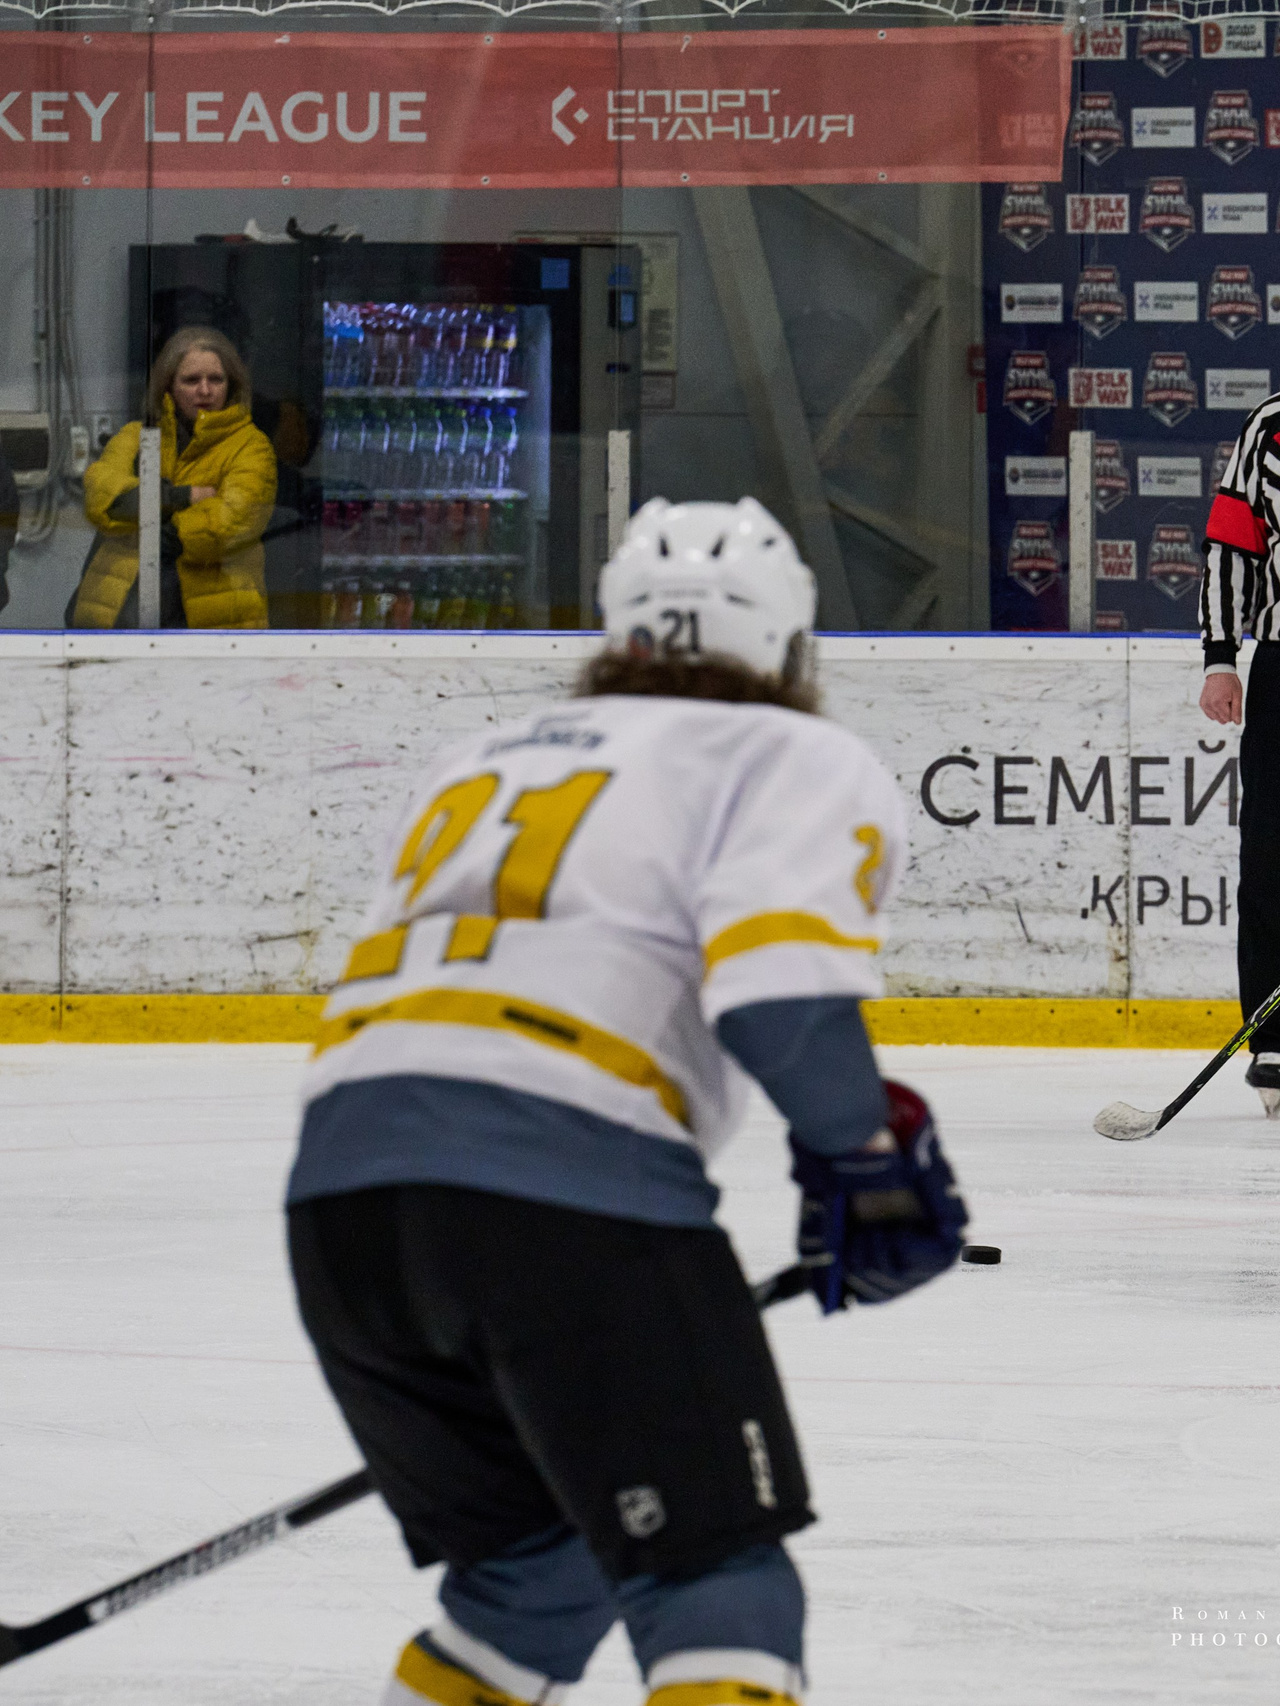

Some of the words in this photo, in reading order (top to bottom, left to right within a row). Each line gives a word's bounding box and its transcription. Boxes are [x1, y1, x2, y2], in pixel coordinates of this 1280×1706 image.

[607, 89, 780, 113] СПОРТ
[144, 91, 428, 143] LEAGUE
[607, 114, 854, 143] СТАНЦИЯ
[1095, 197, 1125, 212] SILK
[1096, 215, 1126, 230] WAY
[1096, 373, 1127, 388] SILK
[1096, 390, 1128, 404] WAY
[1101, 544, 1132, 559] SILK
[1103, 561, 1132, 576] WAY
[657, 609, 700, 656] 21
[920, 739, 1239, 826] СЕМЕЙ
